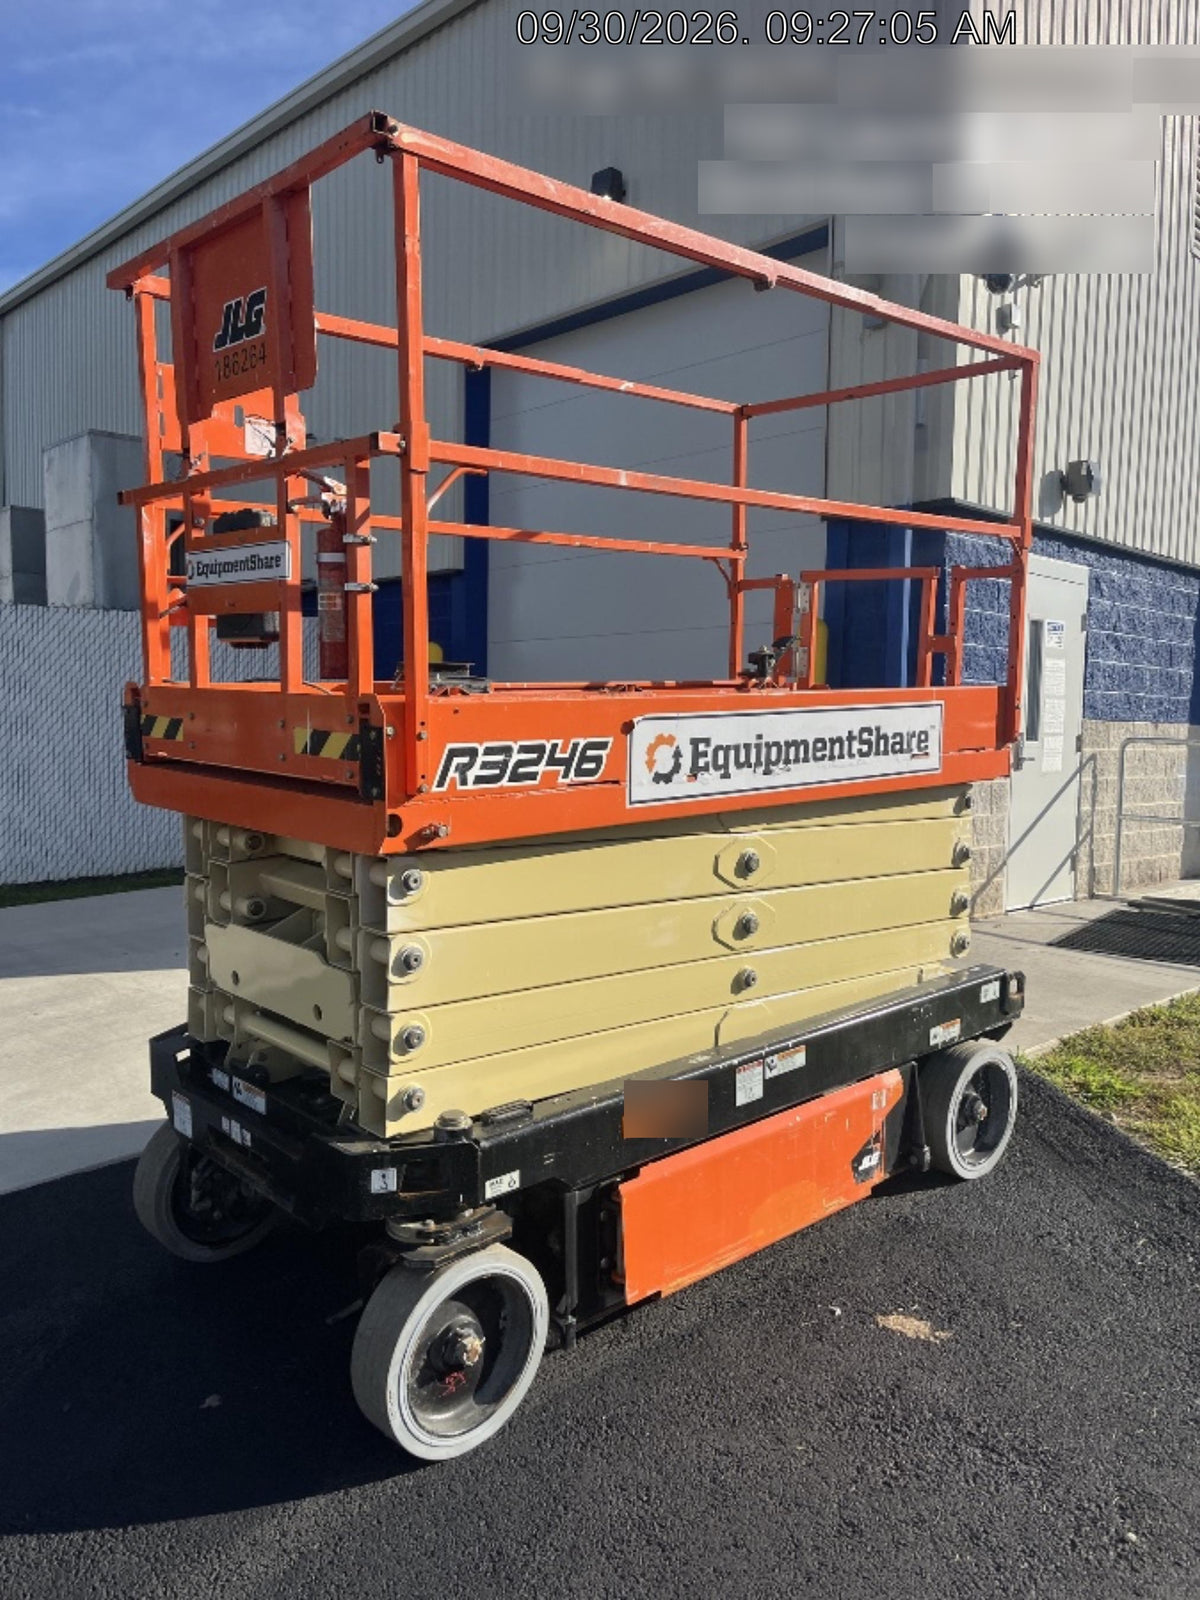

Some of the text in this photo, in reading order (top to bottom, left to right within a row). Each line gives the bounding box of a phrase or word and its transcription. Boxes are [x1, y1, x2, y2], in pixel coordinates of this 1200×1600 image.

[213, 286, 267, 352] JLG
[215, 342, 267, 382] 186264
[196, 554, 282, 579] EquipmentShare
[431, 737, 613, 792] R3246
[690, 726, 929, 779] EquipmentShare
